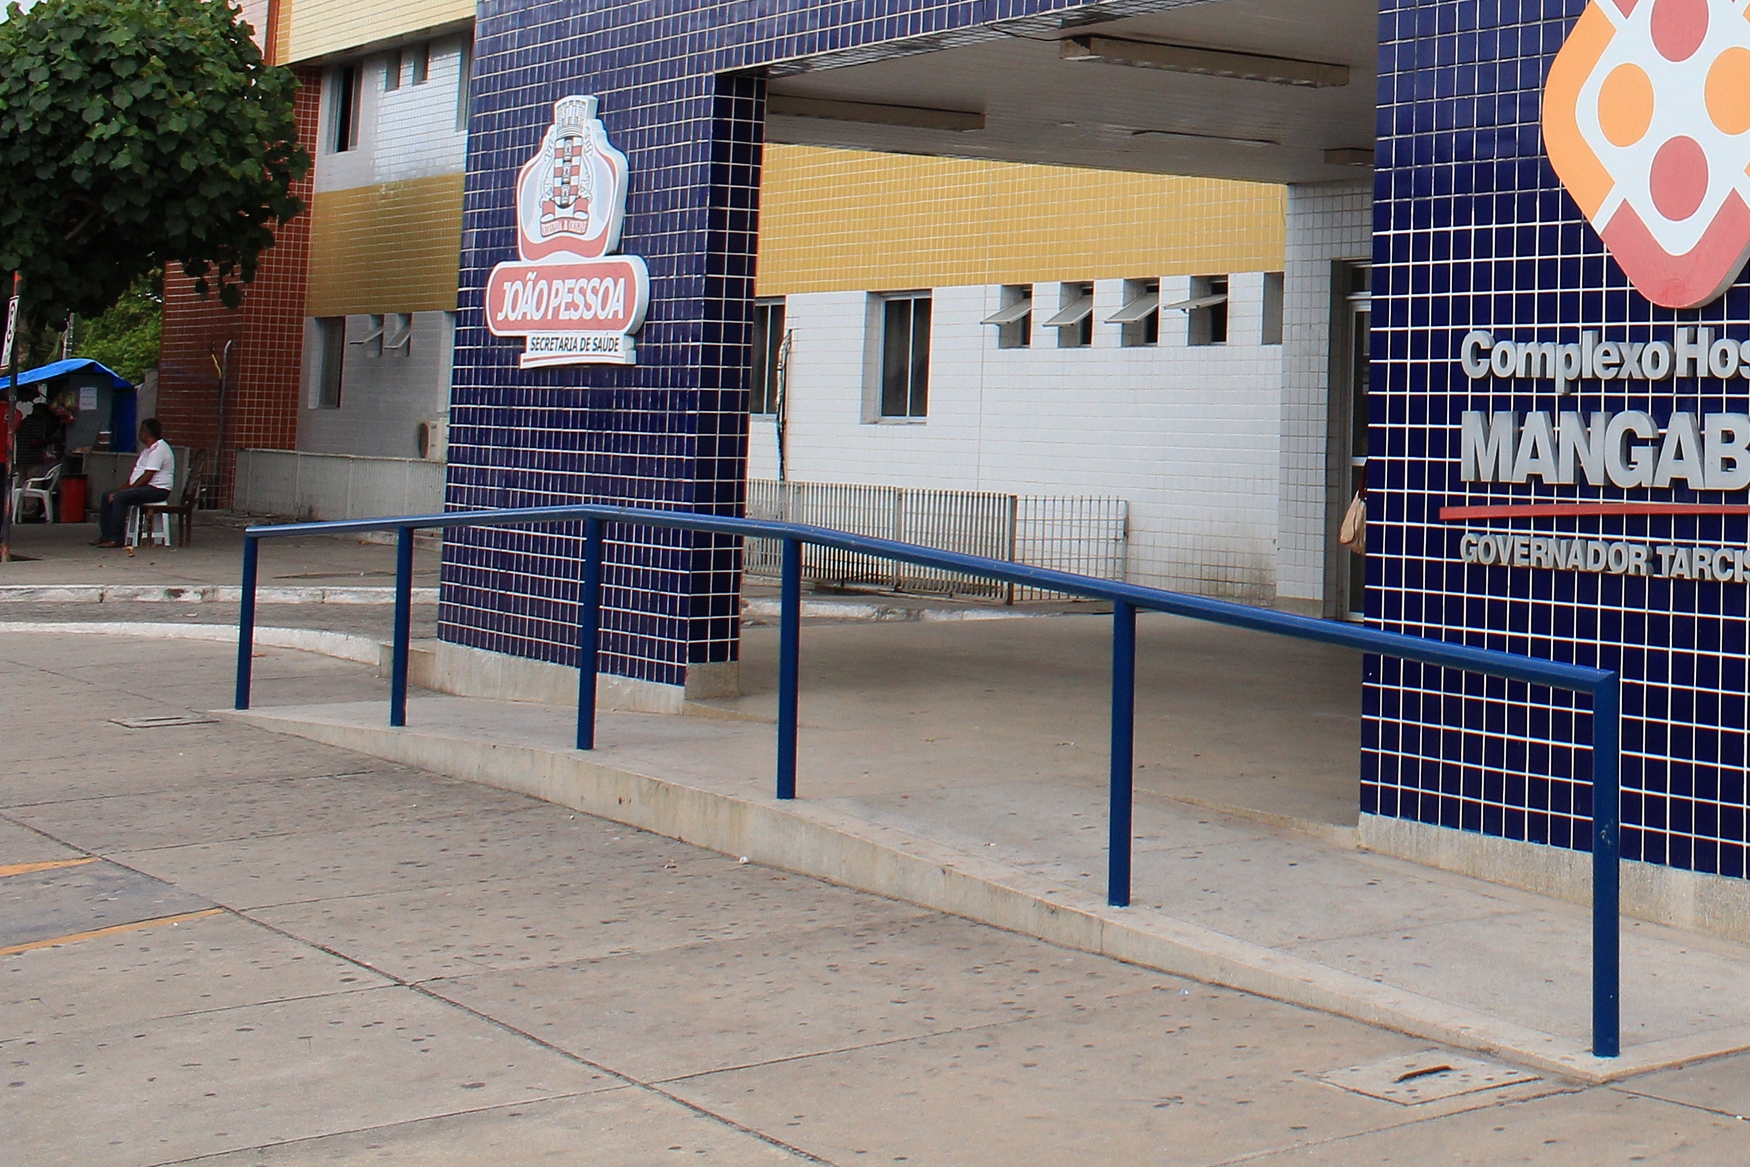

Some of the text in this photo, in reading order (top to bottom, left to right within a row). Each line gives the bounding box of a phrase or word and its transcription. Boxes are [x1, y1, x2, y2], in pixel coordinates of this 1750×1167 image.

[498, 272, 625, 321] JOÃO PESSOA
[530, 332, 620, 353] SECRETARIA DE SAÚDE
[1461, 328, 1675, 395] Complexo
[1460, 532, 1654, 576] GOVERNADOR
